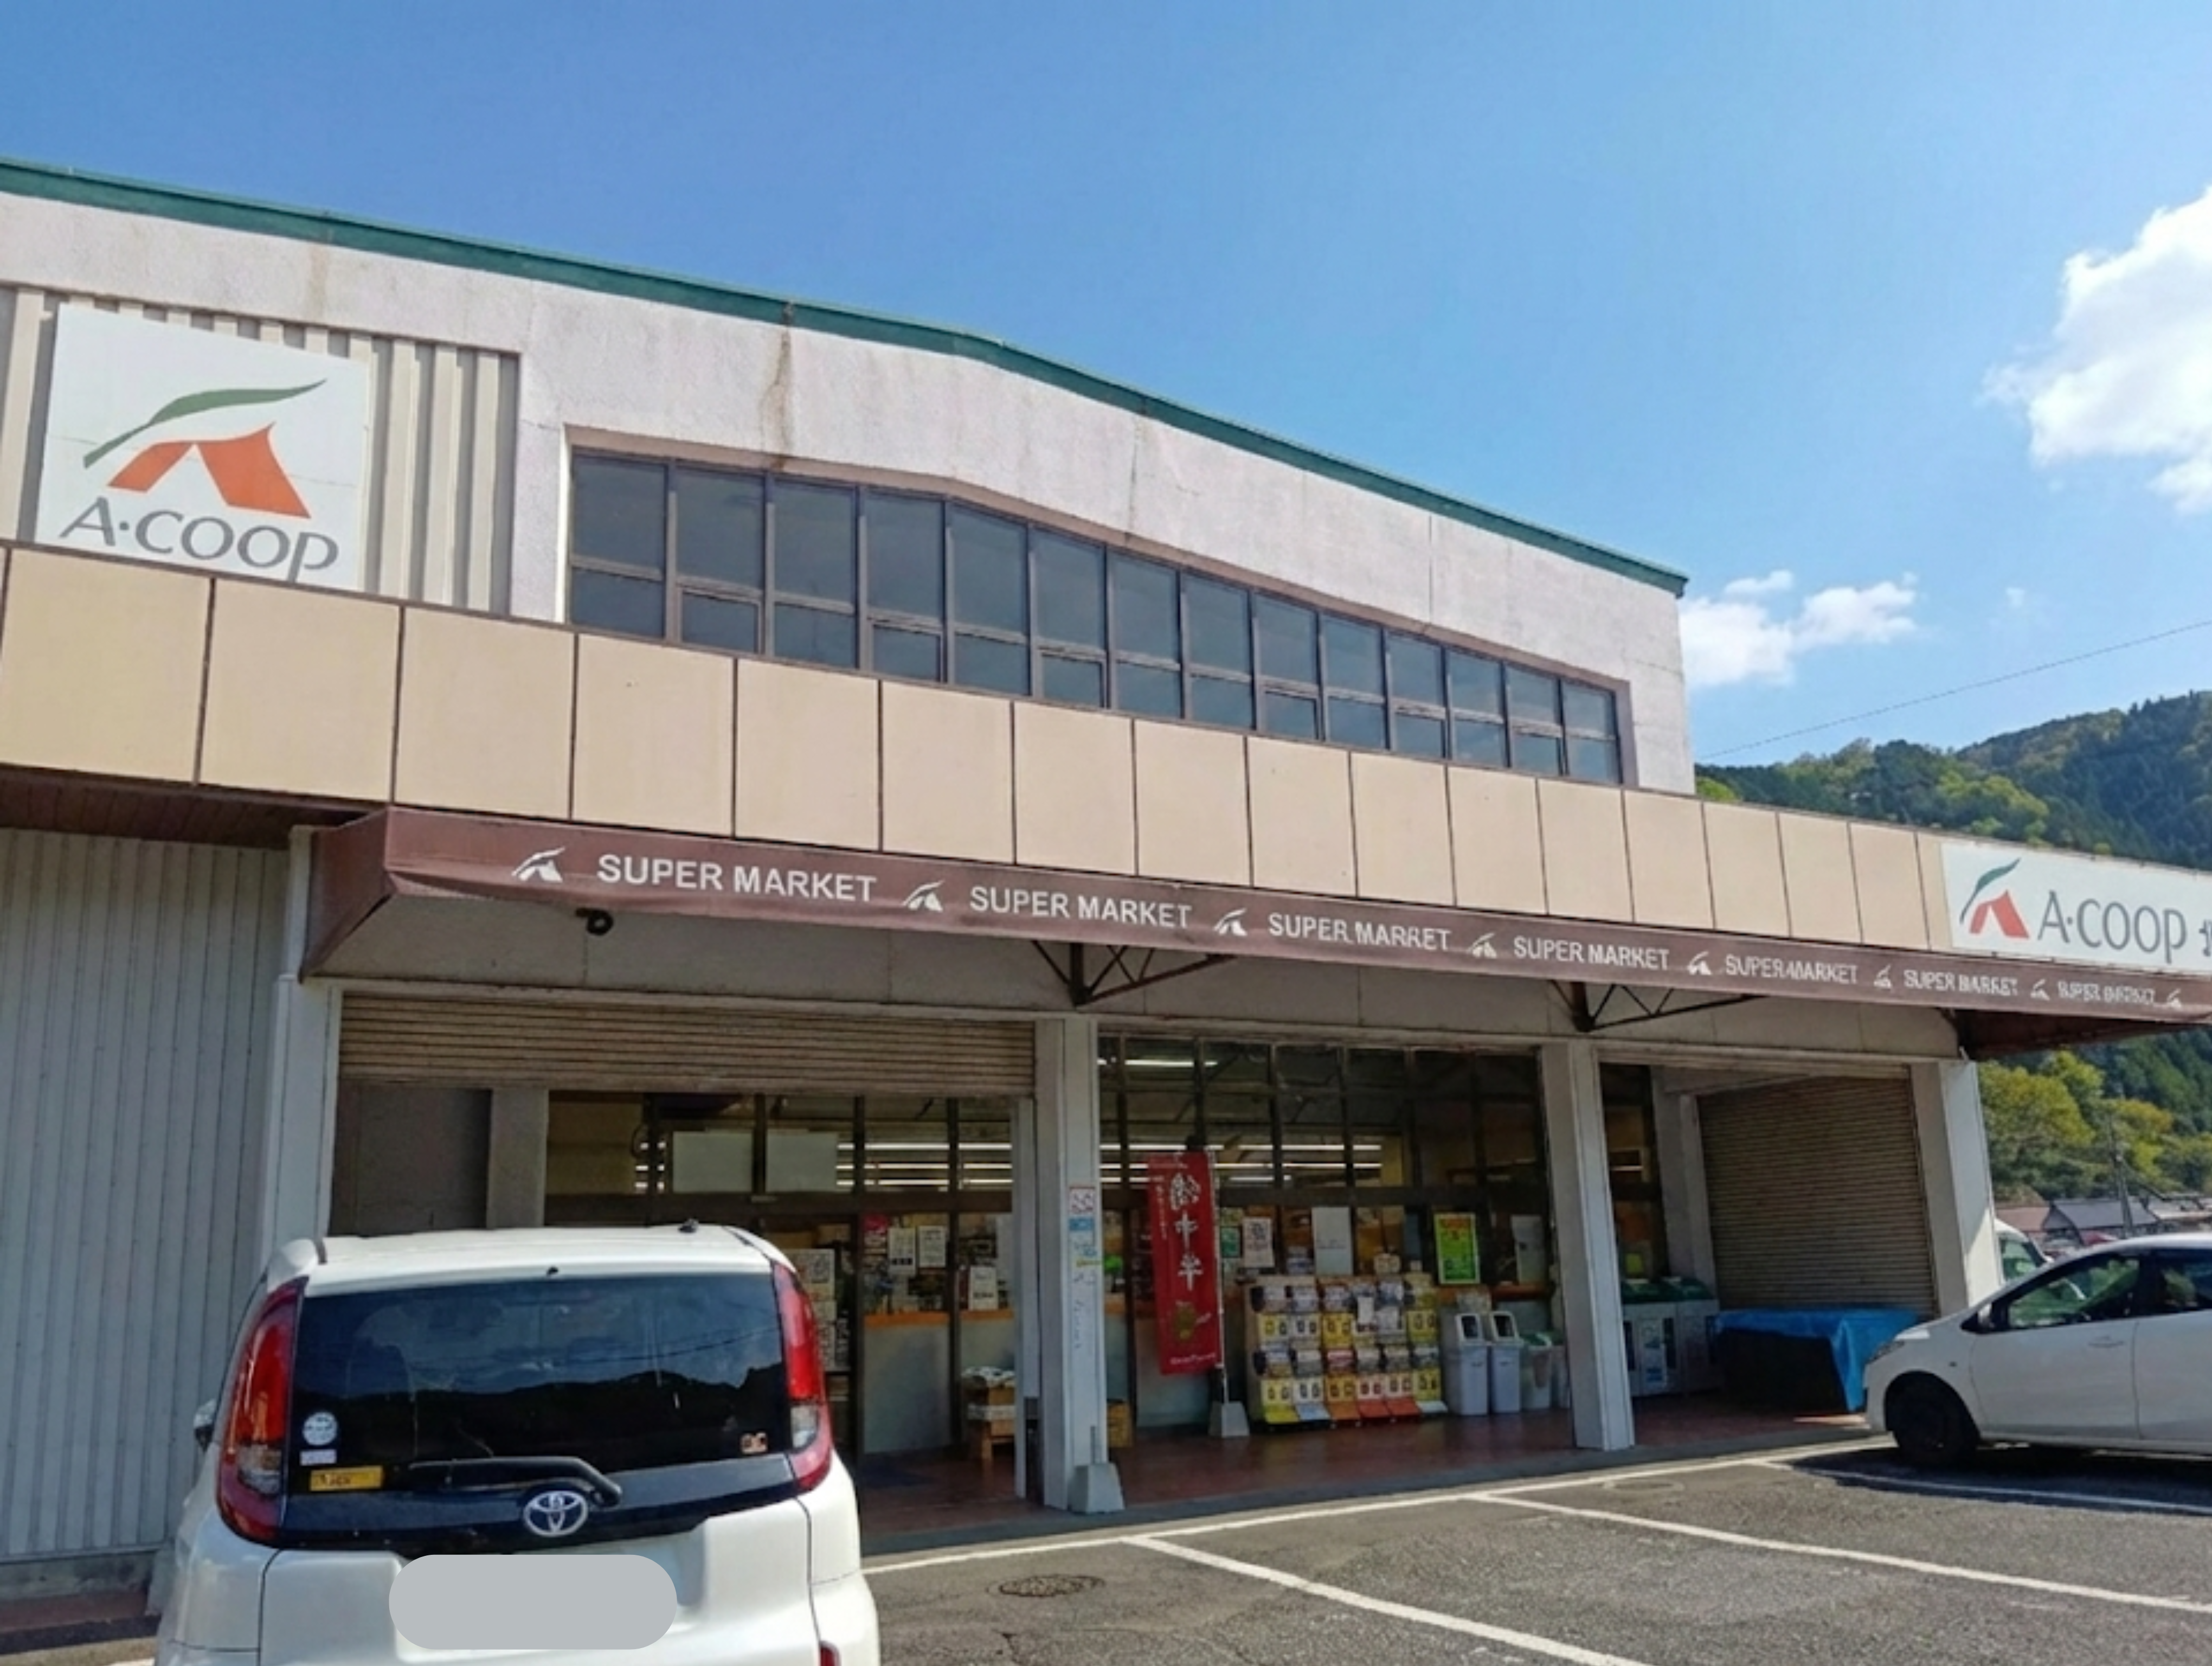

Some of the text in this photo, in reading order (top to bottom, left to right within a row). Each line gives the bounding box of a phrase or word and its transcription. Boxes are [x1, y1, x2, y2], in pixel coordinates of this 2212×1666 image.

[597, 854, 876, 901] SUPER MARKET
[969, 886, 1192, 928] SUPER MARKET
[1268, 912, 1452, 952] SUPER MARKET
[1513, 935, 1670, 971] SUPER MARKET
[1725, 953, 1859, 984] SUPER MARKET
